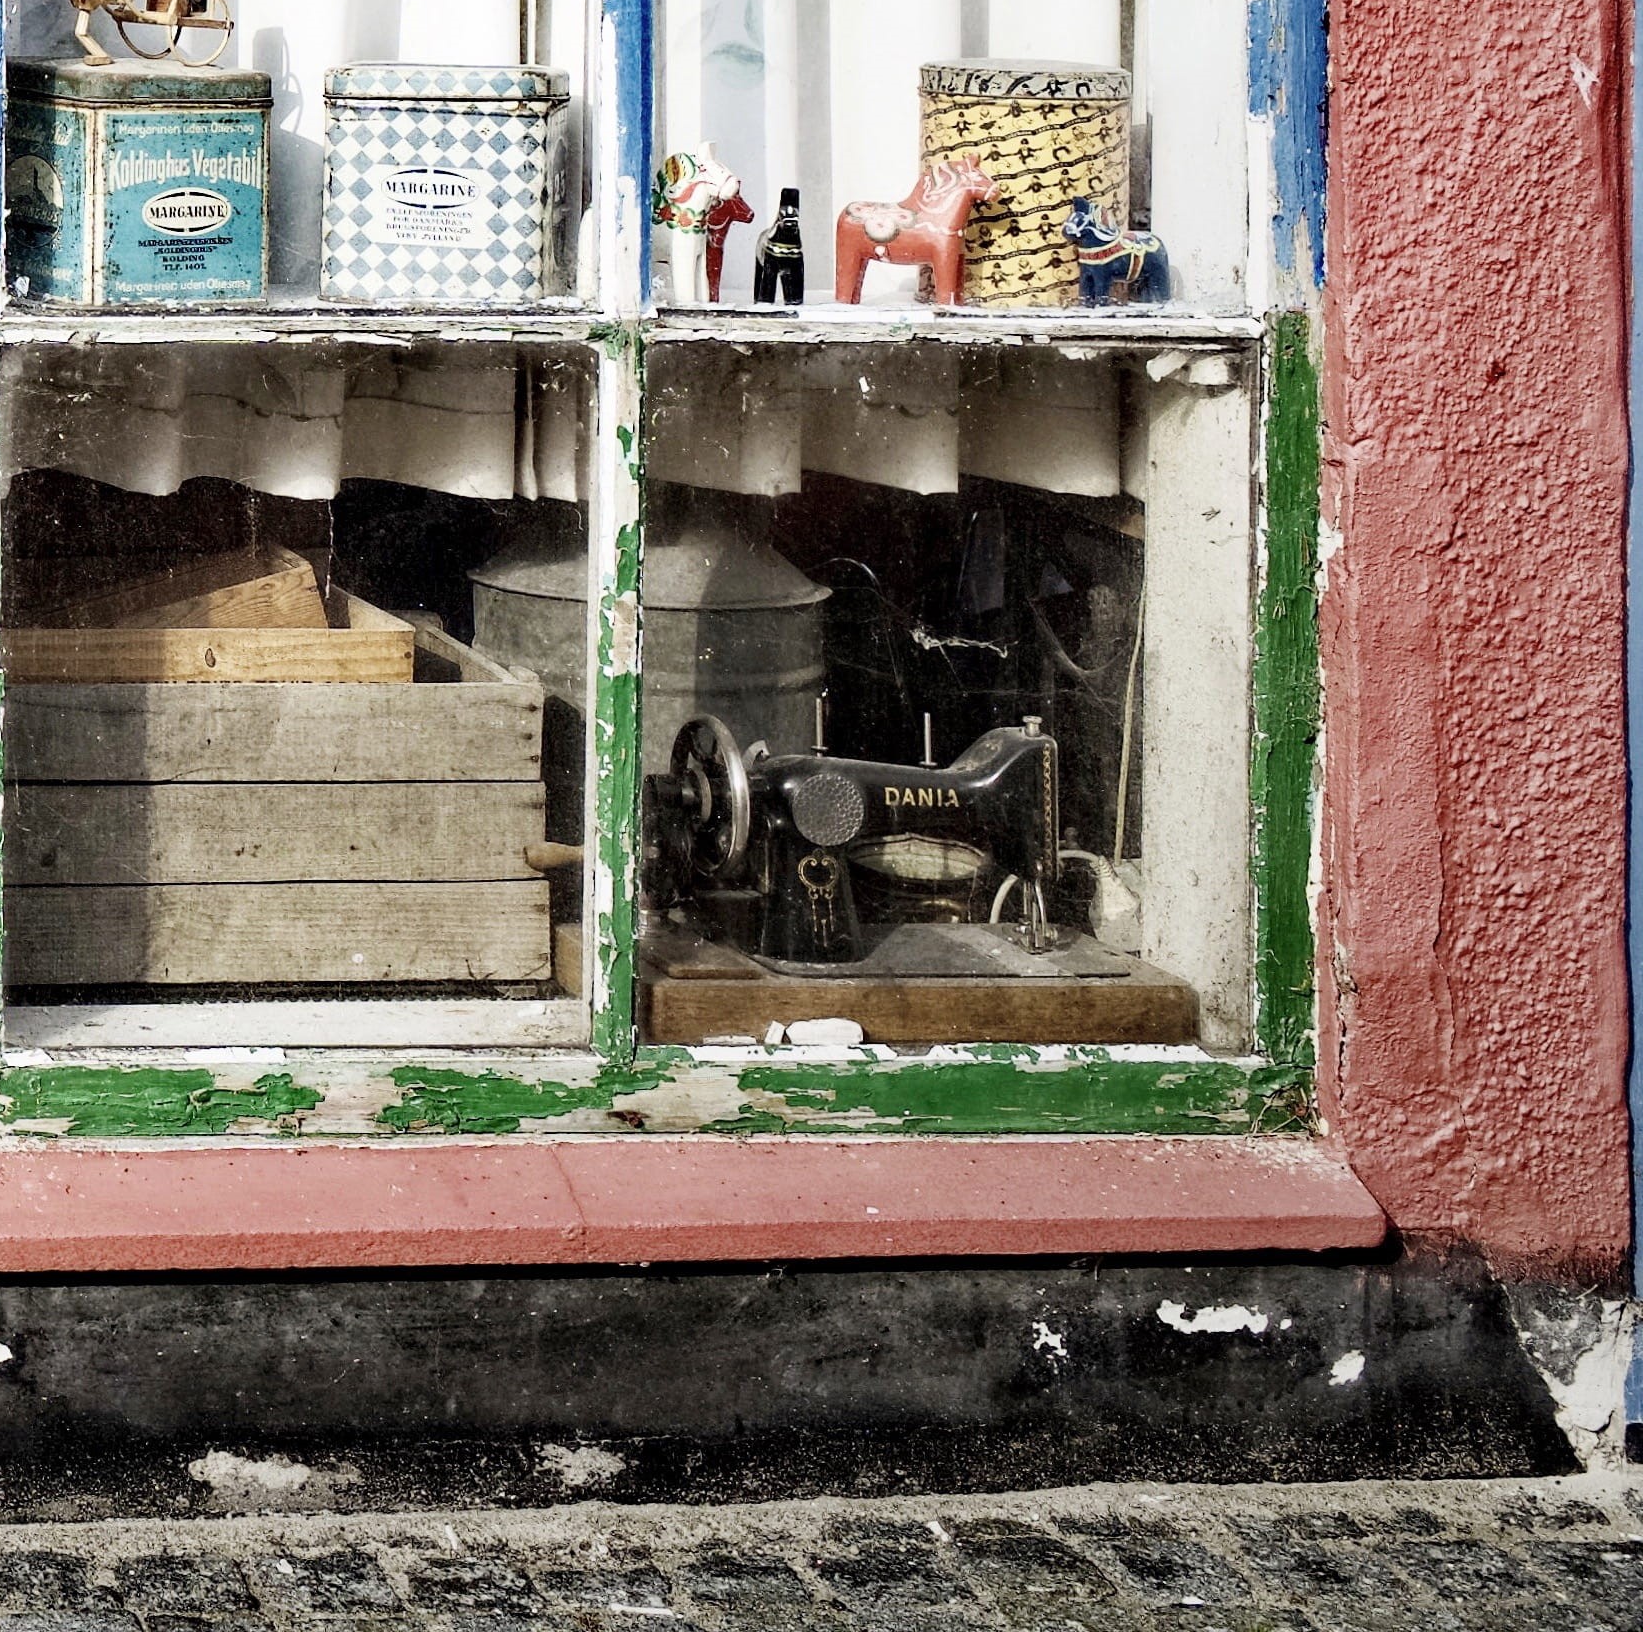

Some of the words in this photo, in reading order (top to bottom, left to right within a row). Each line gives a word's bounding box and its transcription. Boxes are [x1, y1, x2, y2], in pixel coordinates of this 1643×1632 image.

[107, 149, 191, 193] Koldinghus
[191, 147, 262, 190] Vegetabil
[386, 181, 476, 198] MARGARINE
[150, 205, 226, 219] MARGARINE
[162, 254, 205, 263] KOLDING
[884, 786, 961, 808] DANIA
